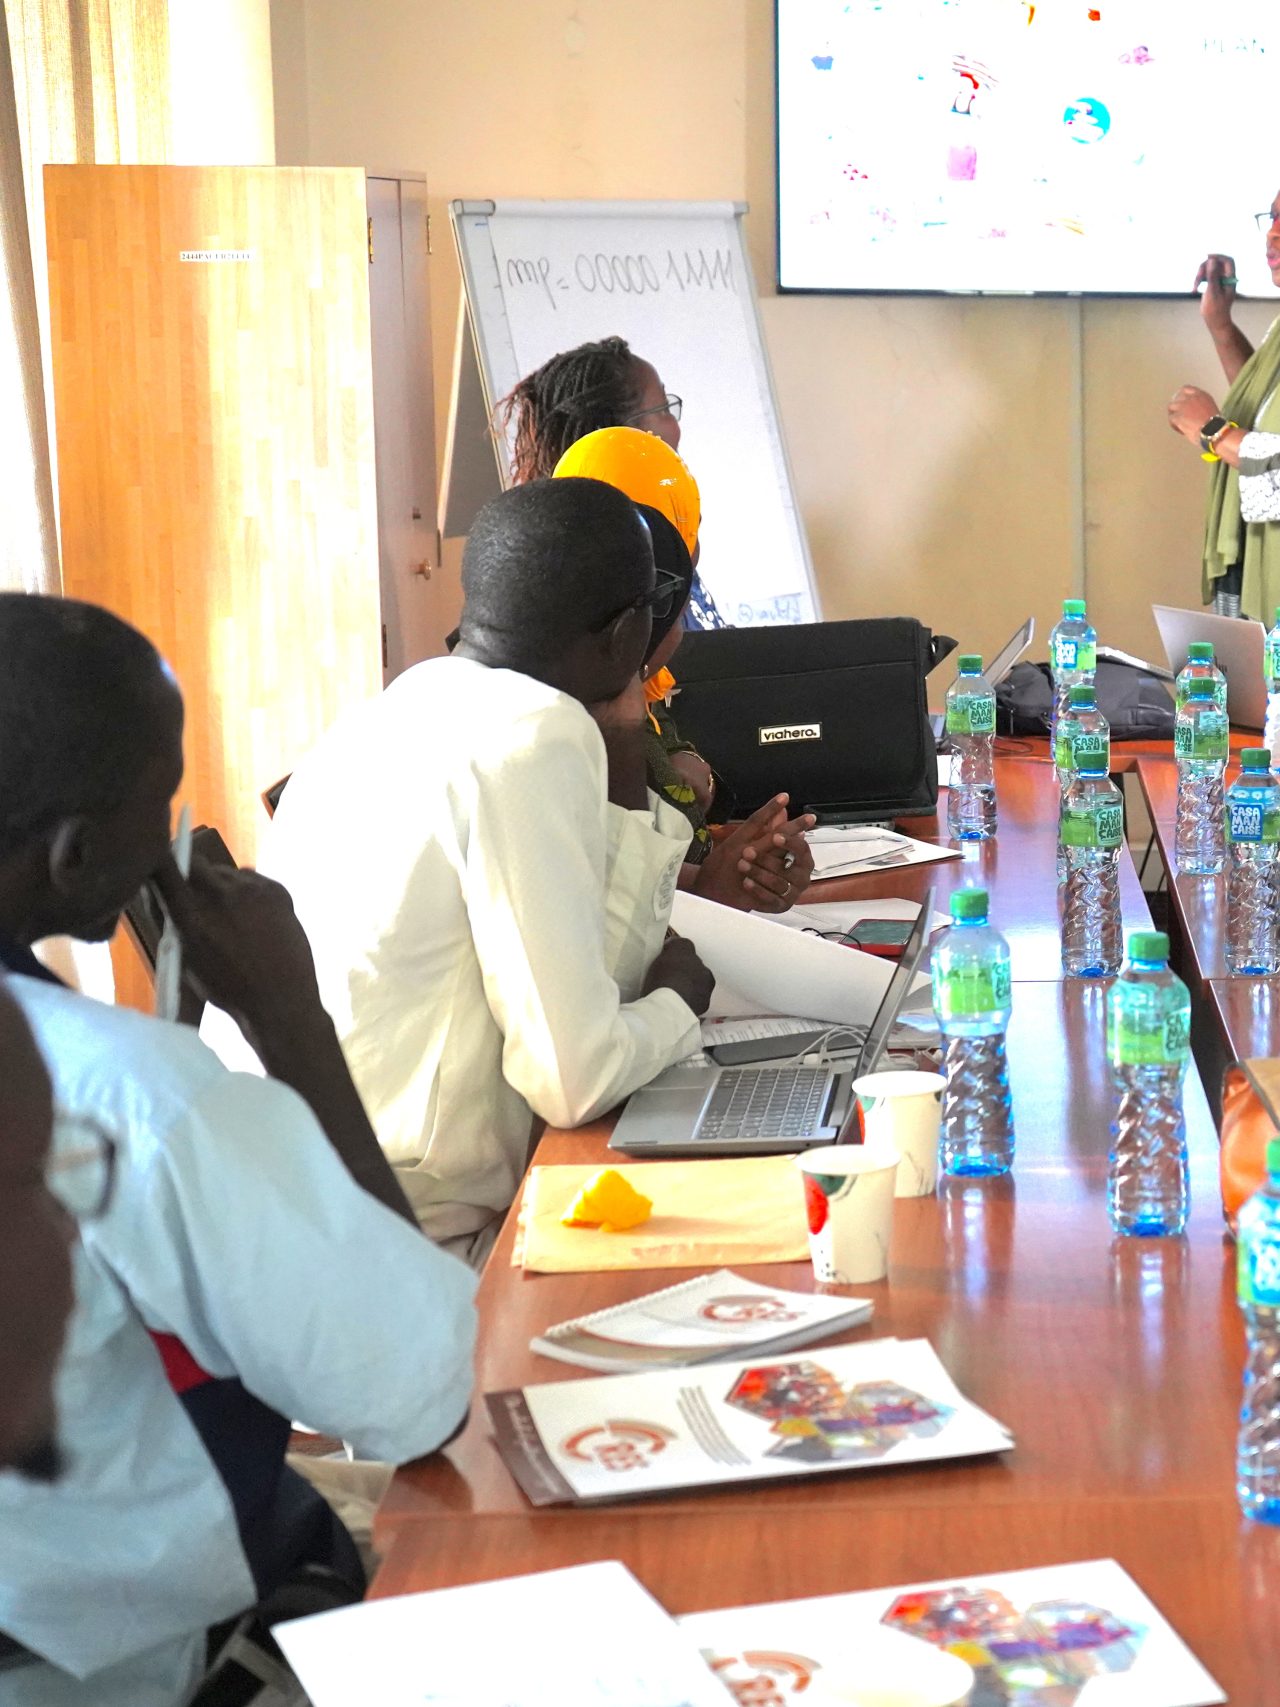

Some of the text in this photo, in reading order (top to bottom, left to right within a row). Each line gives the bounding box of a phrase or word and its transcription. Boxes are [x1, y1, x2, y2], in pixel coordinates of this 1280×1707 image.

[1073, 737, 1100, 748] CASA
[1231, 806, 1261, 817] CASA
[1231, 815, 1261, 826] MAN
